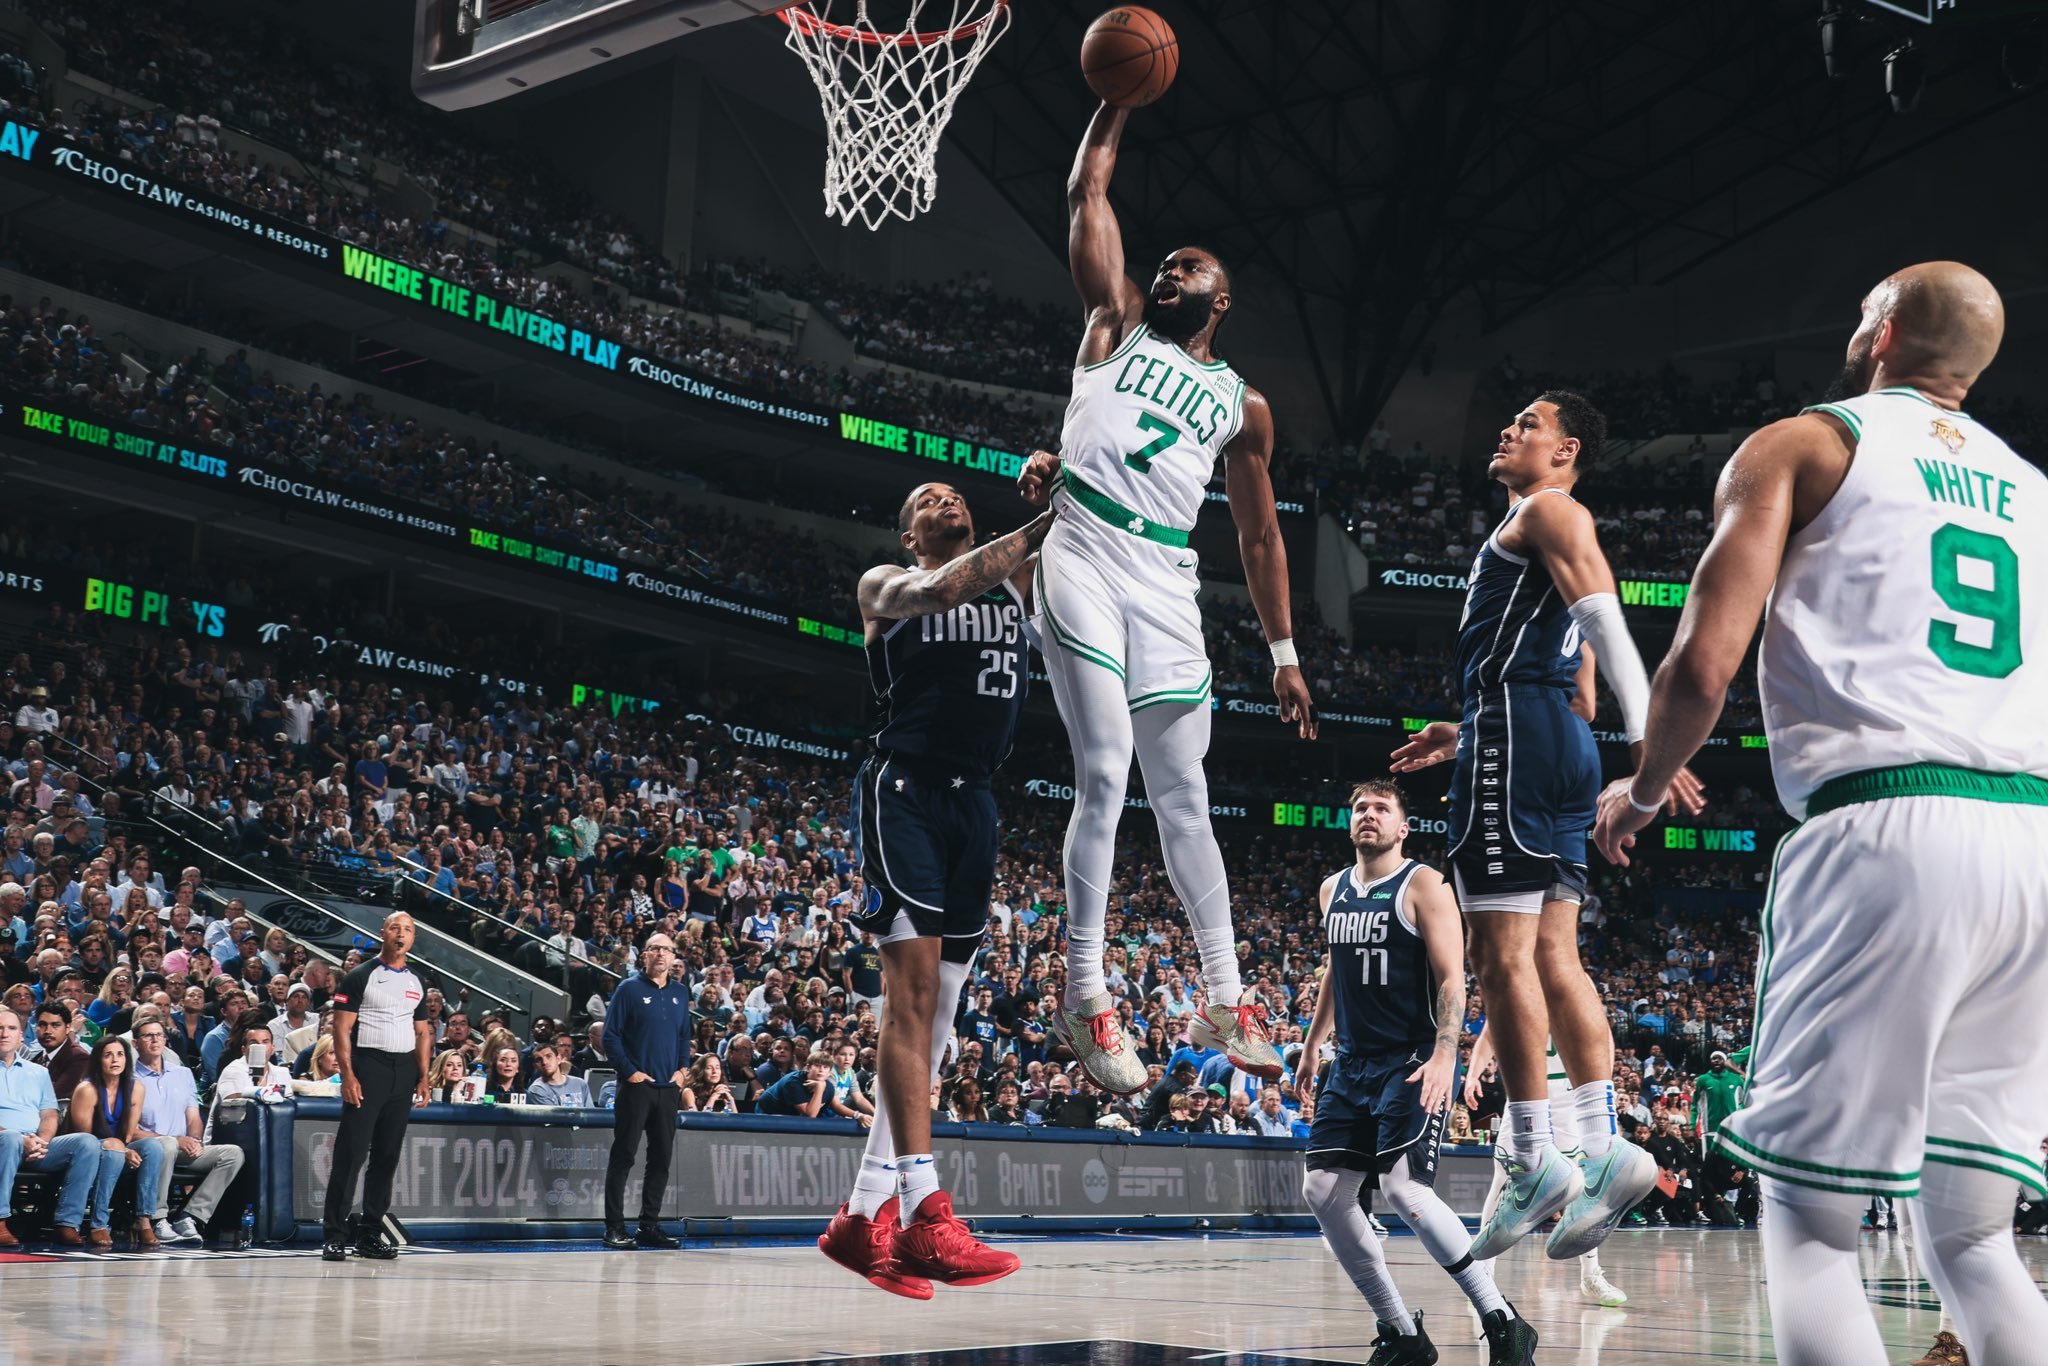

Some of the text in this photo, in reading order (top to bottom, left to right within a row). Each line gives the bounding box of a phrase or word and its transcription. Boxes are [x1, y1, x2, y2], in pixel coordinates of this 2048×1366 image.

[65, 150, 329, 259] CHOCTAW CASINOS & RESORTS
[342, 244, 621, 371] WHERE THE PLAYERS PLAY
[637, 358, 829, 428] CHOCTAW CASINOS & RESORTS
[1114, 353, 1228, 446] CELTICS
[22, 405, 228, 478] TAKE YOUR SHOT AT SLOTS
[840, 412, 1030, 480] WHERE THE PLAYER
[1123, 410, 1182, 475] 7
[248, 468, 457, 536] CHOCTAW CASINOS & RESORTS
[1912, 457, 2017, 523] WHITE
[469, 527, 619, 583] TAKE YOUR SHOT AT SLOTS
[84, 577, 228, 639] BIG PLYS
[634, 573, 703, 604] CHOCTAW
[702, 594, 742, 615] CASINOS
[750, 608, 790, 626] RESORTS
[1619, 579, 1690, 609] WHER
[1926, 521, 2024, 680] 9
[977, 648, 1018, 699] 25
[780, 739, 830, 759] CASINOS
[1273, 801, 1307, 828] BIG
[1664, 827, 1757, 852] BIG WINS
[277, 904, 334, 934] Ford
[1328, 910, 1391, 944] MAVS
[1355, 947, 1389, 986] 77
[452, 1136, 535, 1207] 2024
[950, 1157, 979, 1207] 26
[997, 1151, 1040, 1206] 8PM
[1042, 1163, 1062, 1206] ET
[1085, 1172, 1108, 1188] abc
[1117, 1165, 1185, 1197] ESPN
[1206, 1160, 1219, 1203] &
